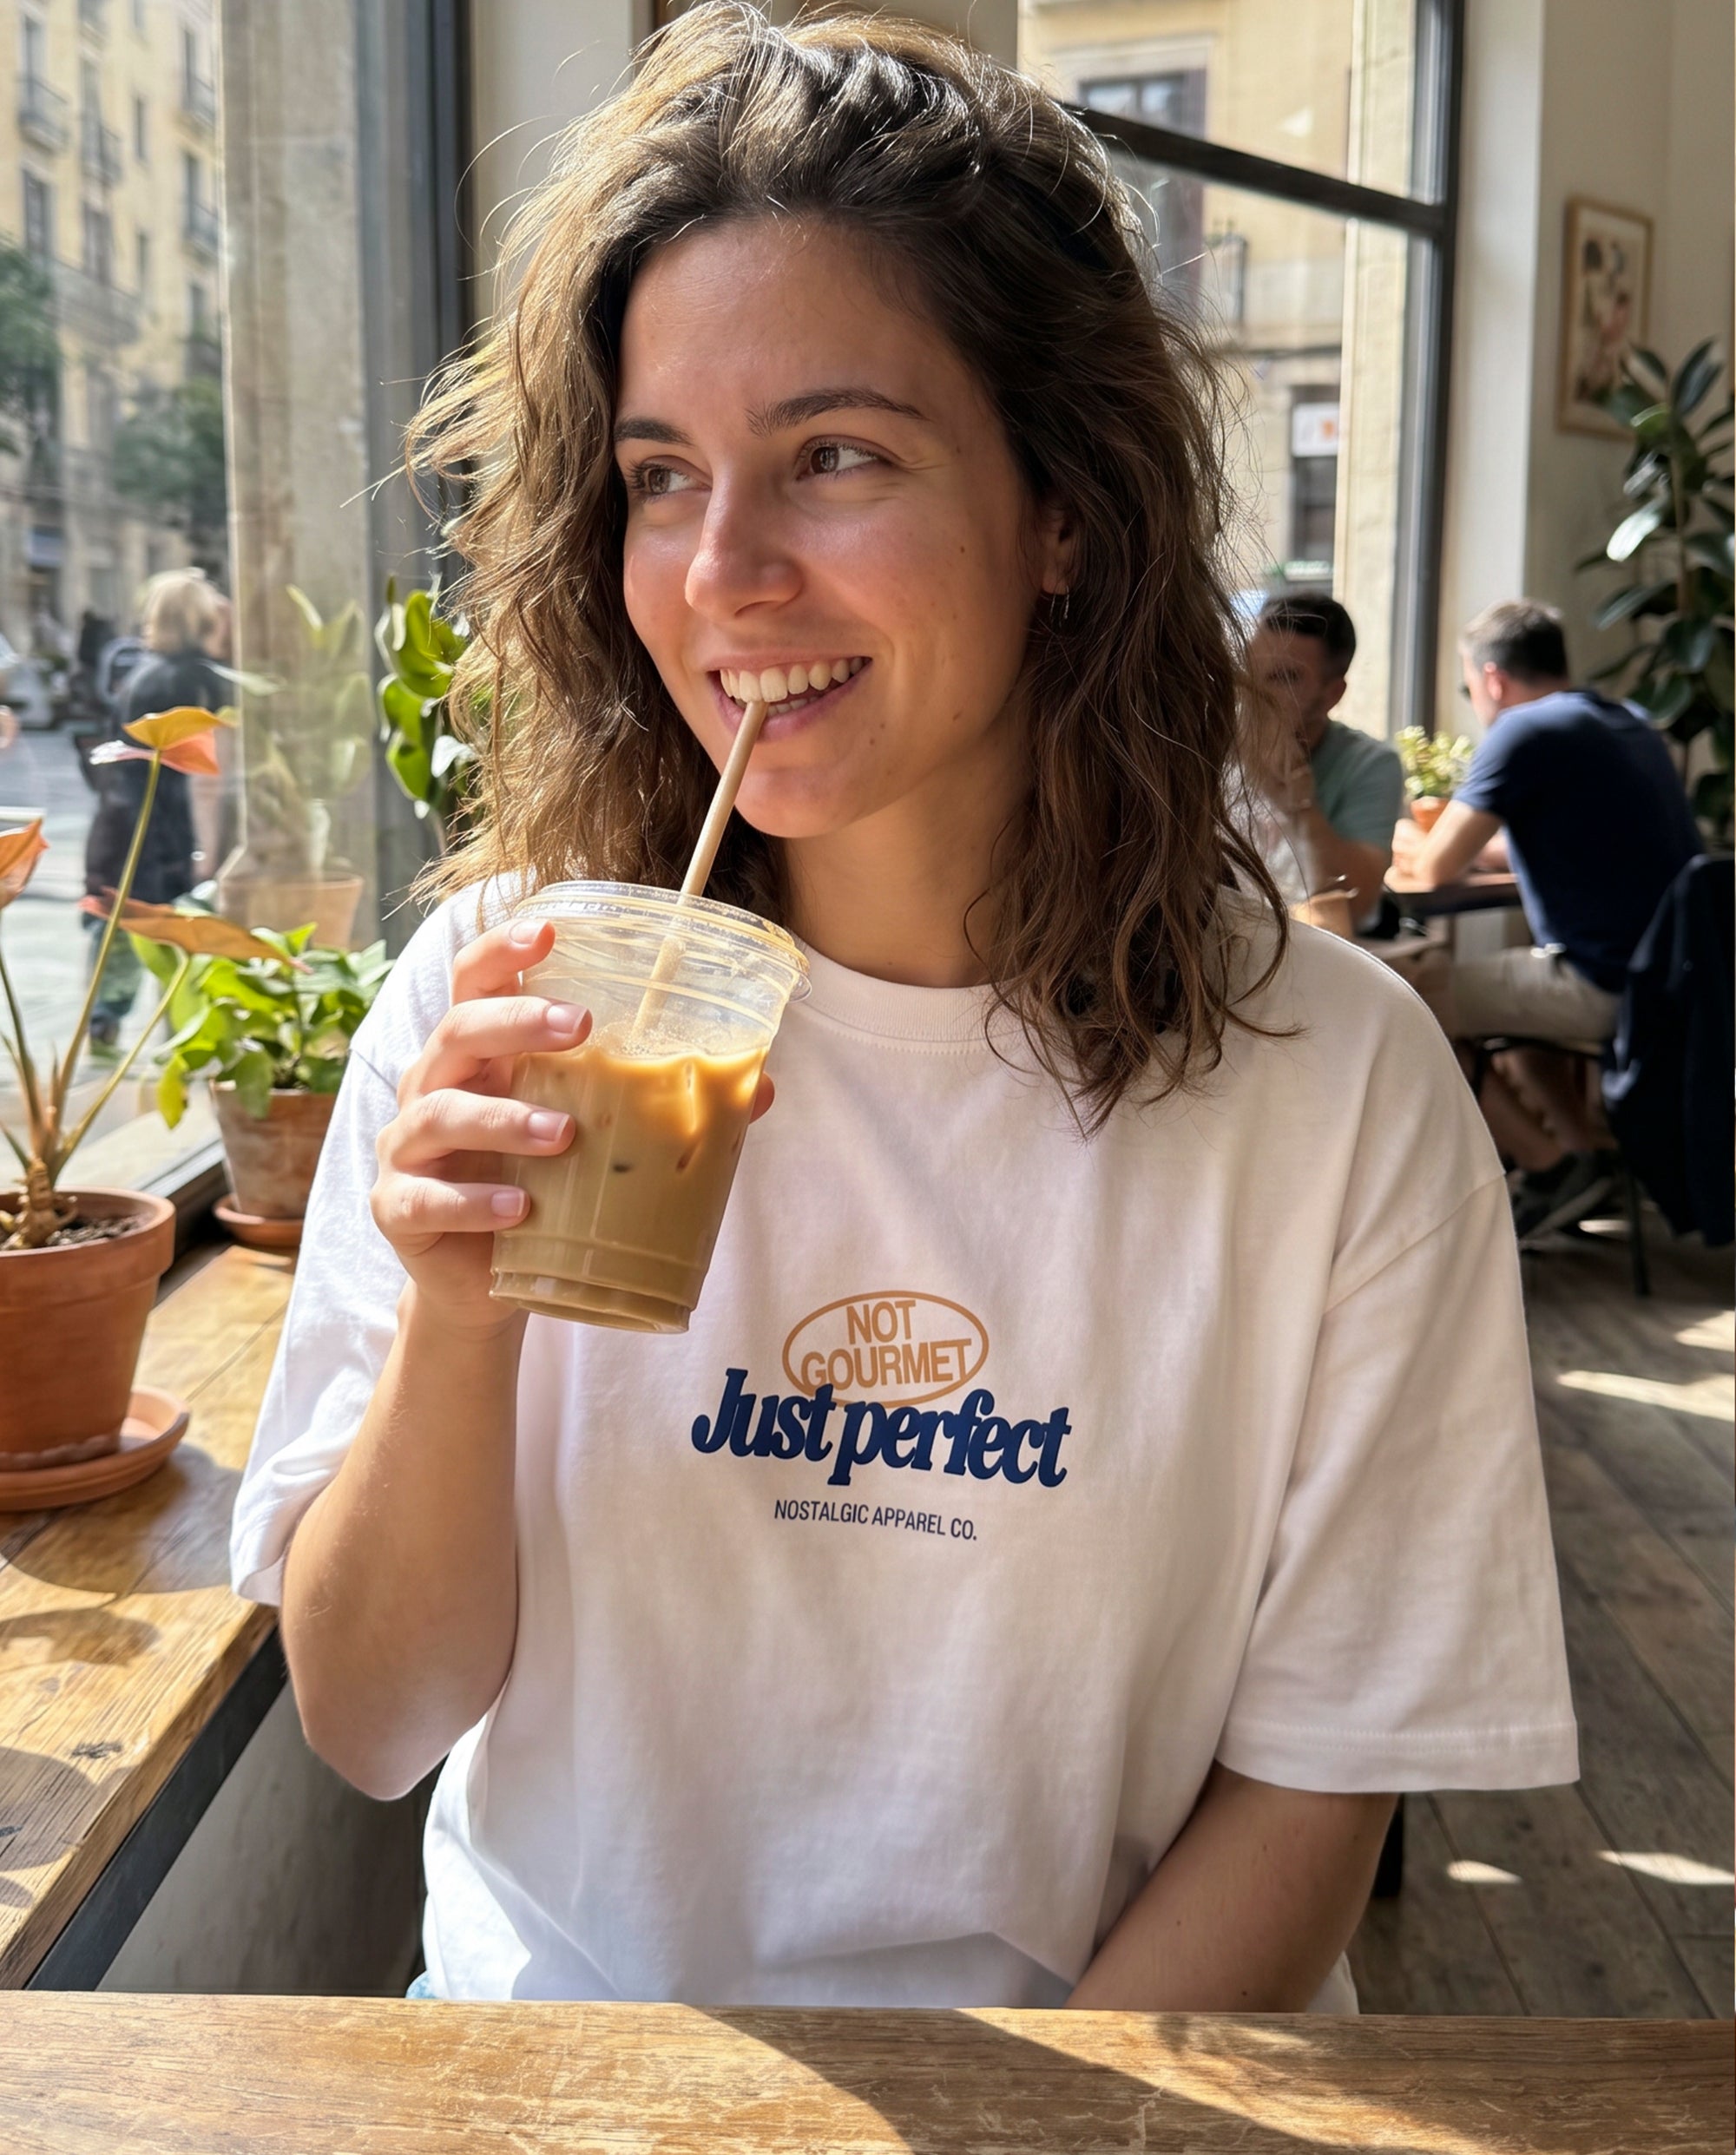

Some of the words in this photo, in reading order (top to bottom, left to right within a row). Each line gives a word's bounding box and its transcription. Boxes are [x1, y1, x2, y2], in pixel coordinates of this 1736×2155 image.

[846, 1299, 917, 1344] NOT
[800, 1338, 973, 1390] GOURMET
[691, 1368, 837, 1462] Just
[827, 1389, 1072, 1488] perfect
[774, 1499, 868, 1524] NOSTALGIC
[872, 1506, 946, 1535] APPAREL
[950, 1518, 977, 1541] CO.
